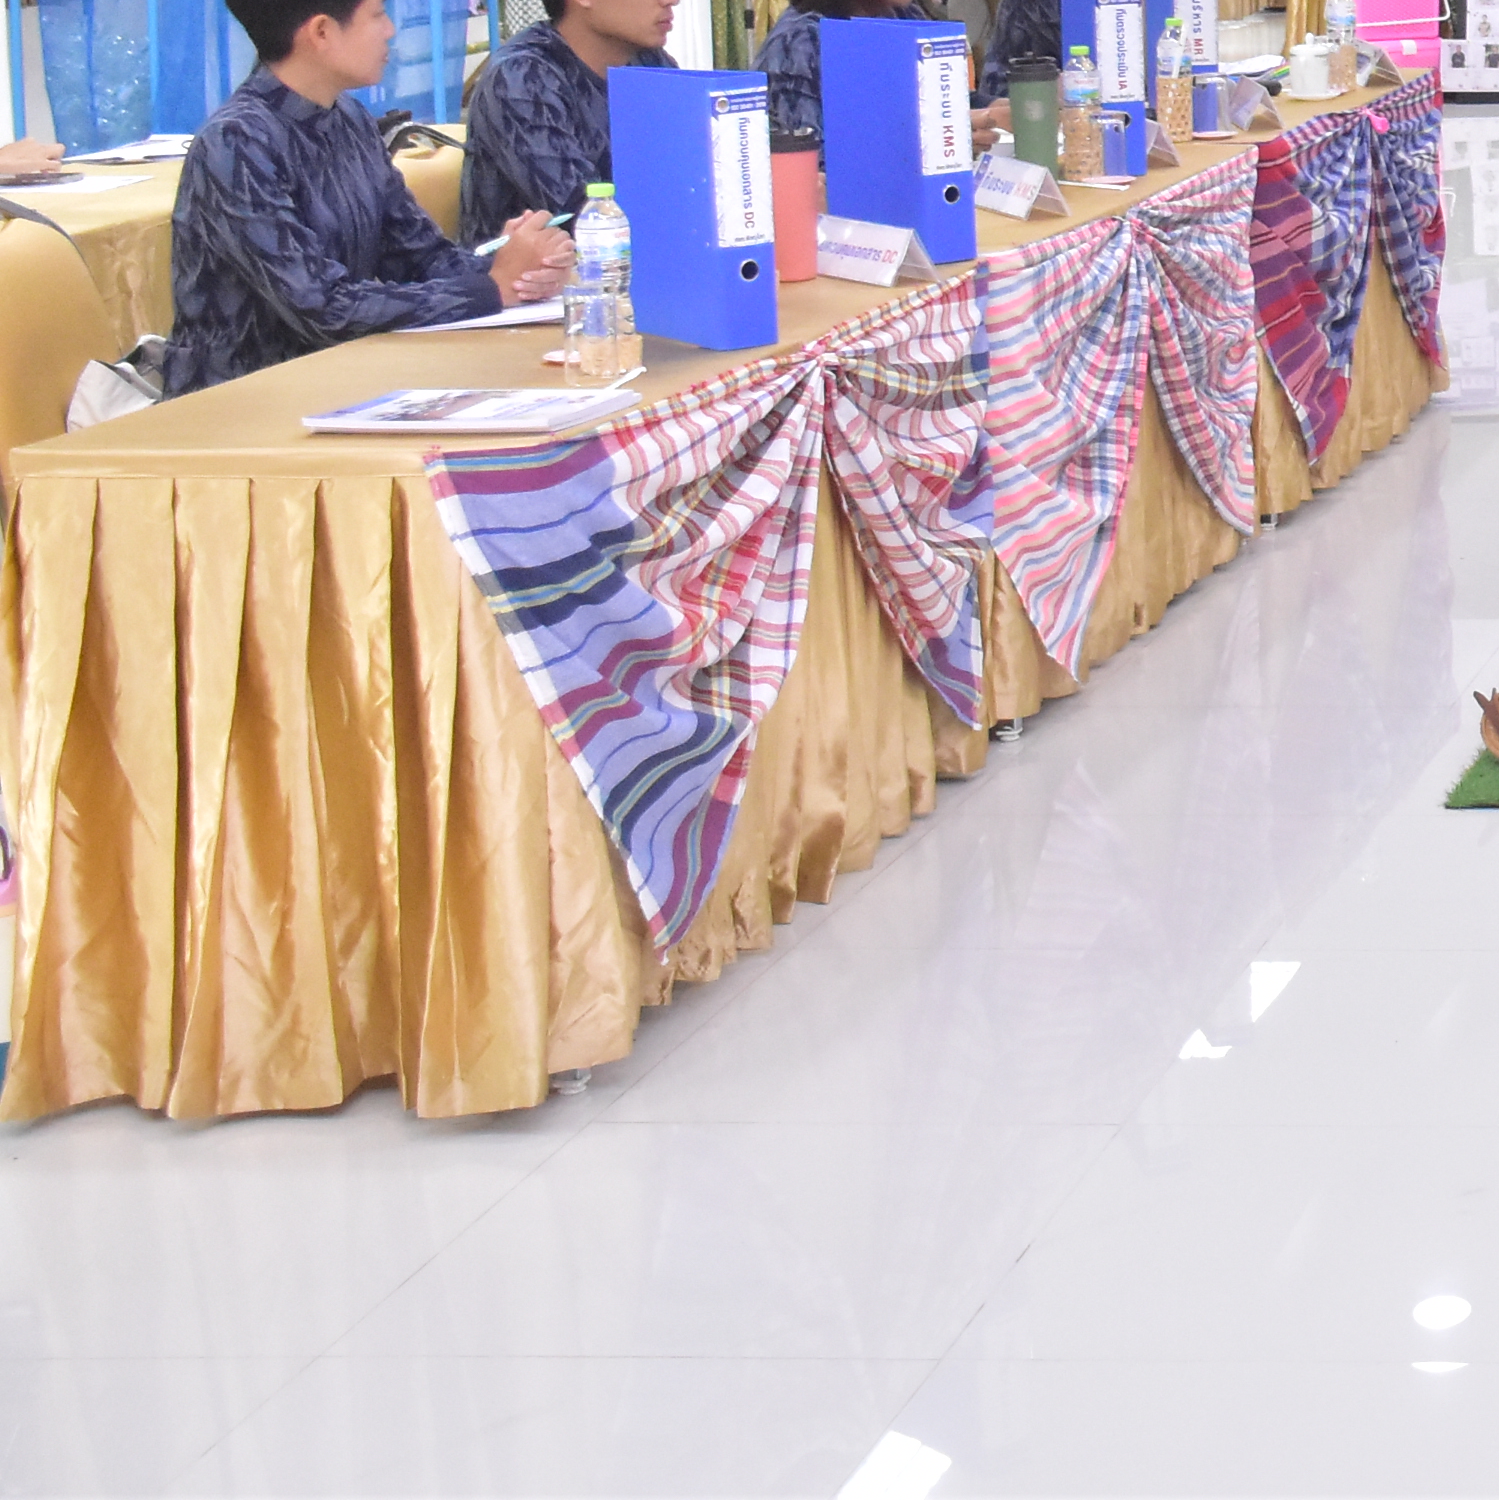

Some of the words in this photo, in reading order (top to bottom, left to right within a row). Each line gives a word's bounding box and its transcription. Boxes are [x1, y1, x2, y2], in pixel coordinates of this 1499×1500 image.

[1193, 38, 1204, 55] MR
[940, 62, 953, 119] ทีมระบบ
[1118, 80, 1128, 90] IA
[943, 125, 956, 158] KMS
[738, 117, 753, 209] ทีมควบคุมเอกสาร
[980, 171, 1015, 195] ทีมระบบ
[1013, 181, 1037, 200] KMS
[744, 211, 755, 229] DC
[882, 249, 898, 263] DC
